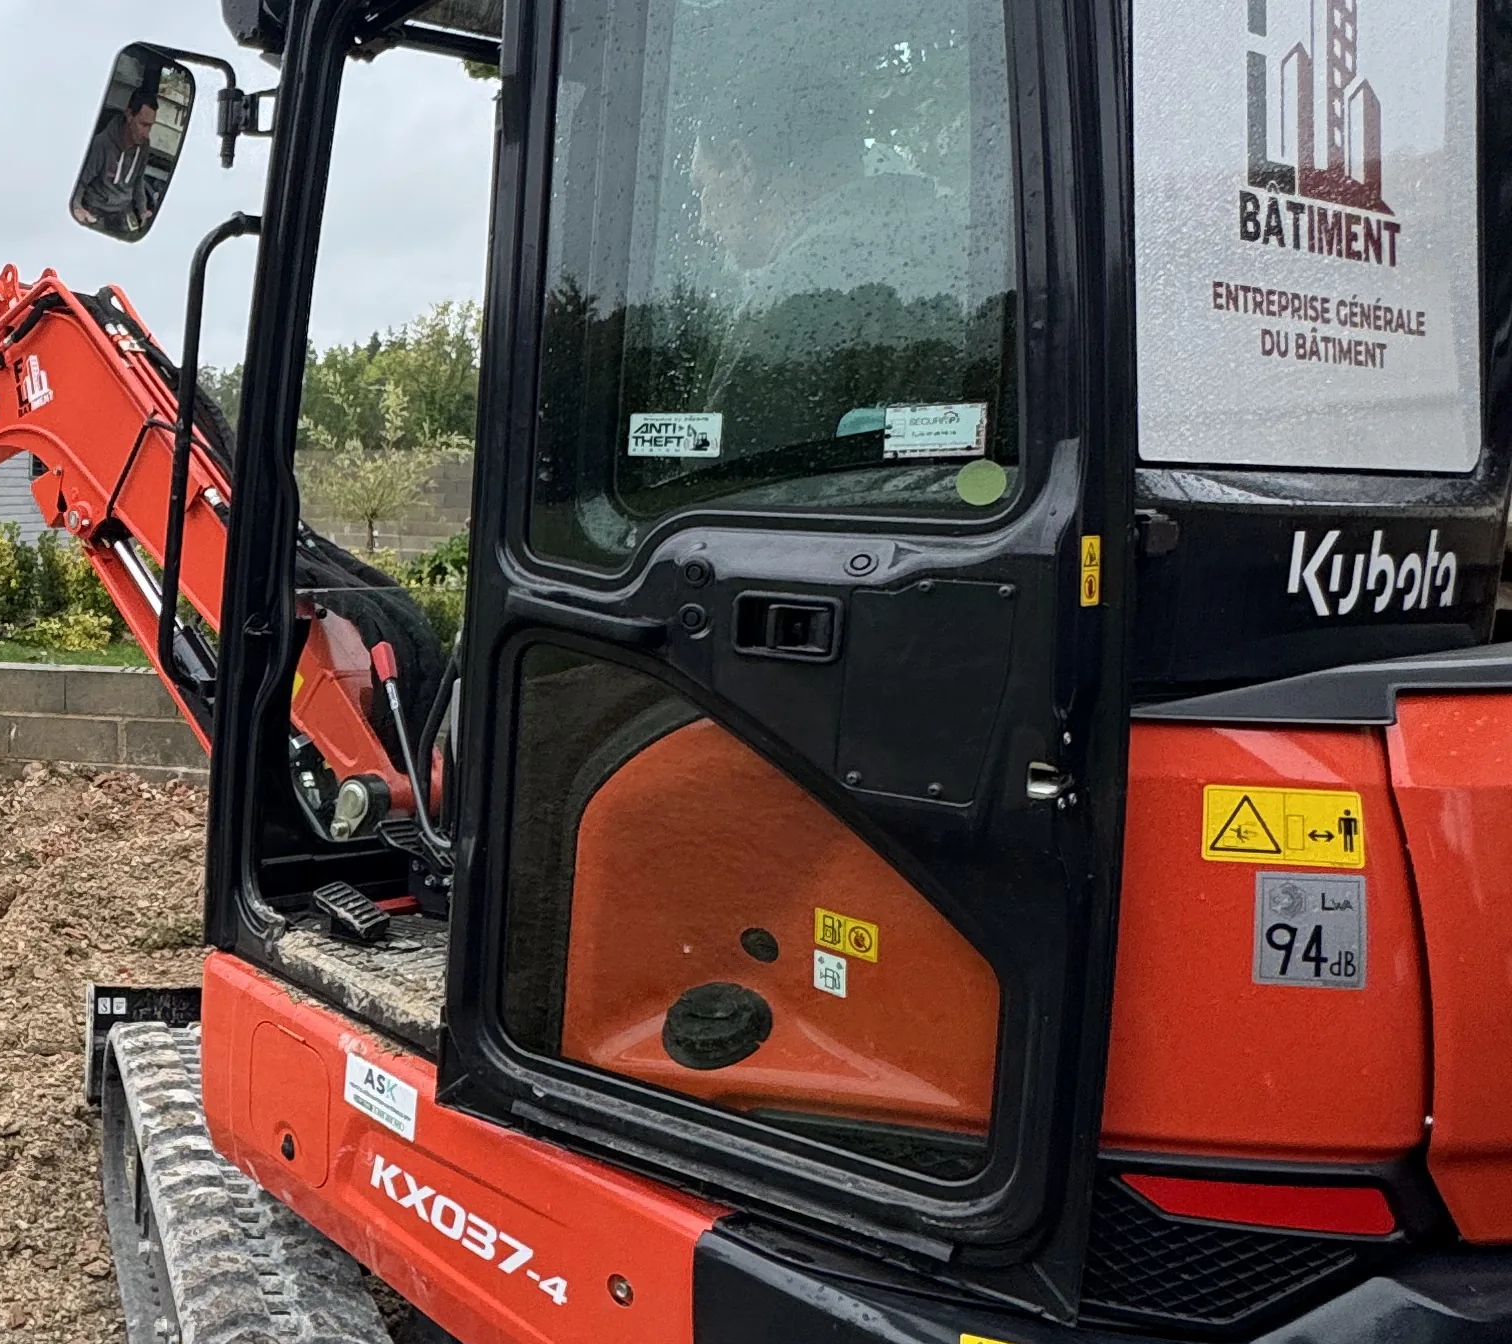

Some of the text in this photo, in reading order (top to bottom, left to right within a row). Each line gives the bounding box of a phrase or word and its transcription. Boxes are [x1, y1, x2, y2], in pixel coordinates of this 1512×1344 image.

[1212, 280, 1426, 337] ENTREPRISE GÉNÉRALE
[1260, 326, 1388, 369] DU BÂTIMENT
[631, 435, 685, 448] THEFT
[633, 422, 677, 435] ANTI
[1287, 529, 1457, 617] Kubota
[1265, 922, 1357, 978] 94 dB
[363, 1068, 398, 1104] ASK
[370, 1154, 568, 1306] KX037-4
